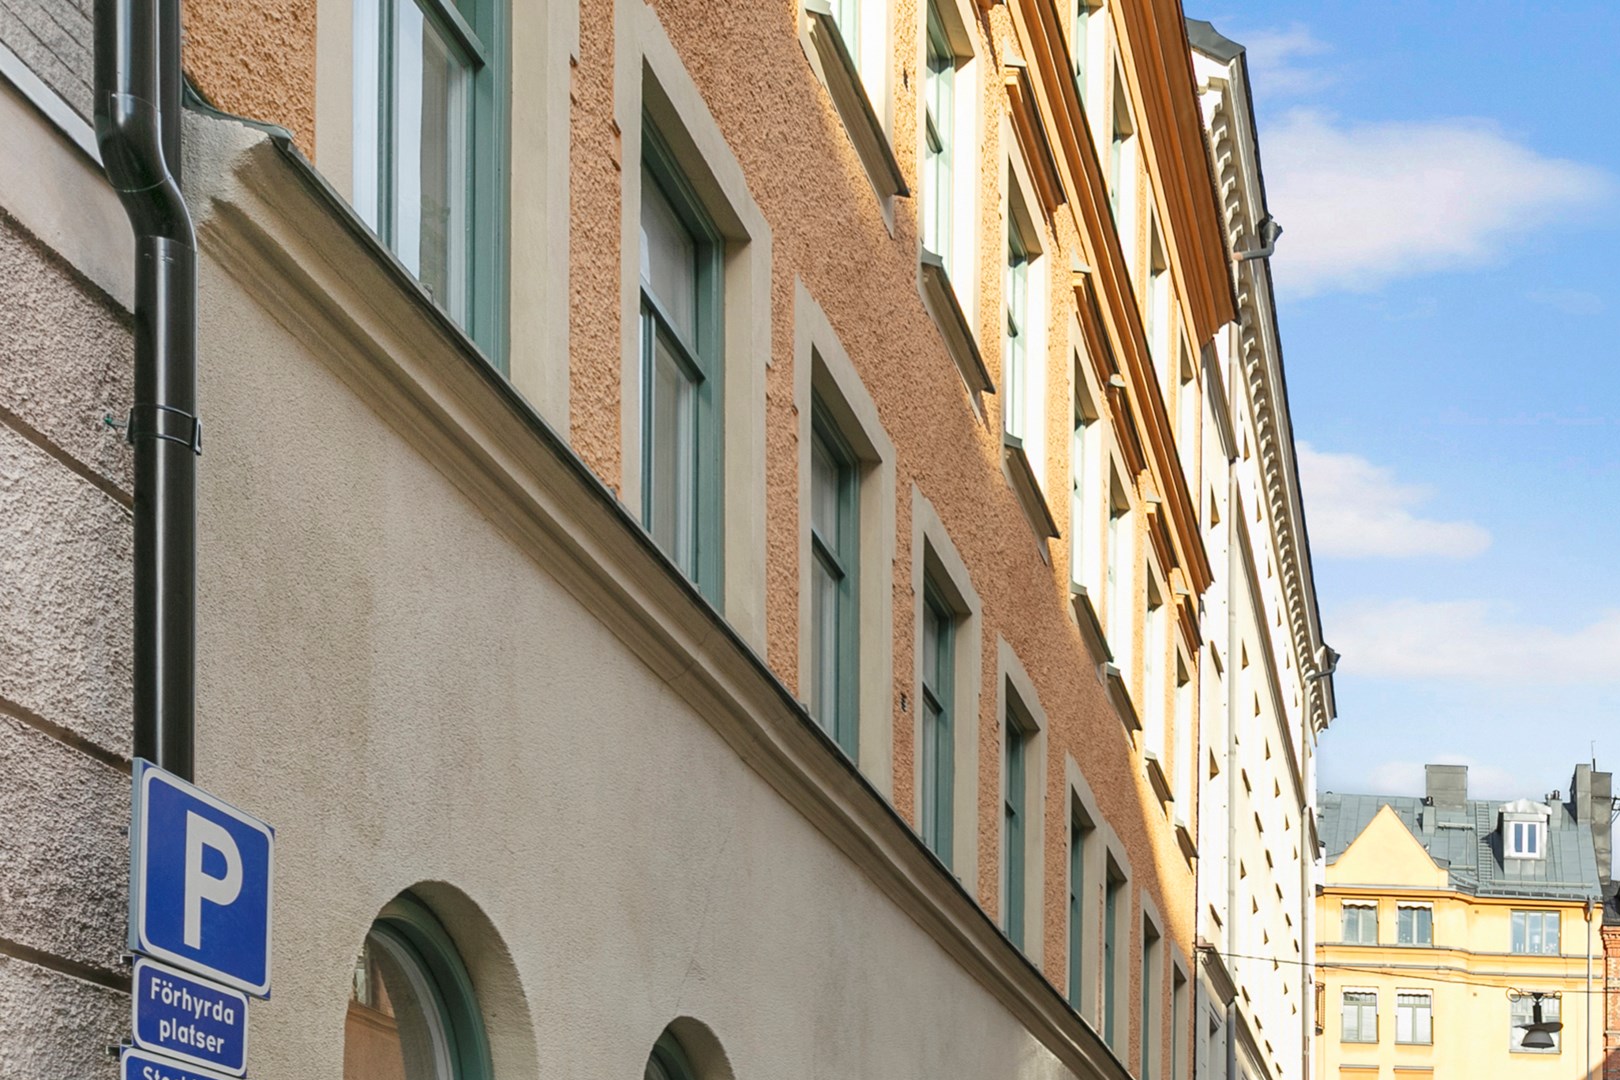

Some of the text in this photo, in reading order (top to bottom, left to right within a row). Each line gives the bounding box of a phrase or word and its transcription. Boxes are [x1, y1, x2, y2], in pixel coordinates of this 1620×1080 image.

[184, 810, 243, 950] P
[151, 976, 235, 1025] Förhyrda
[160, 1018, 225, 1054] platser
